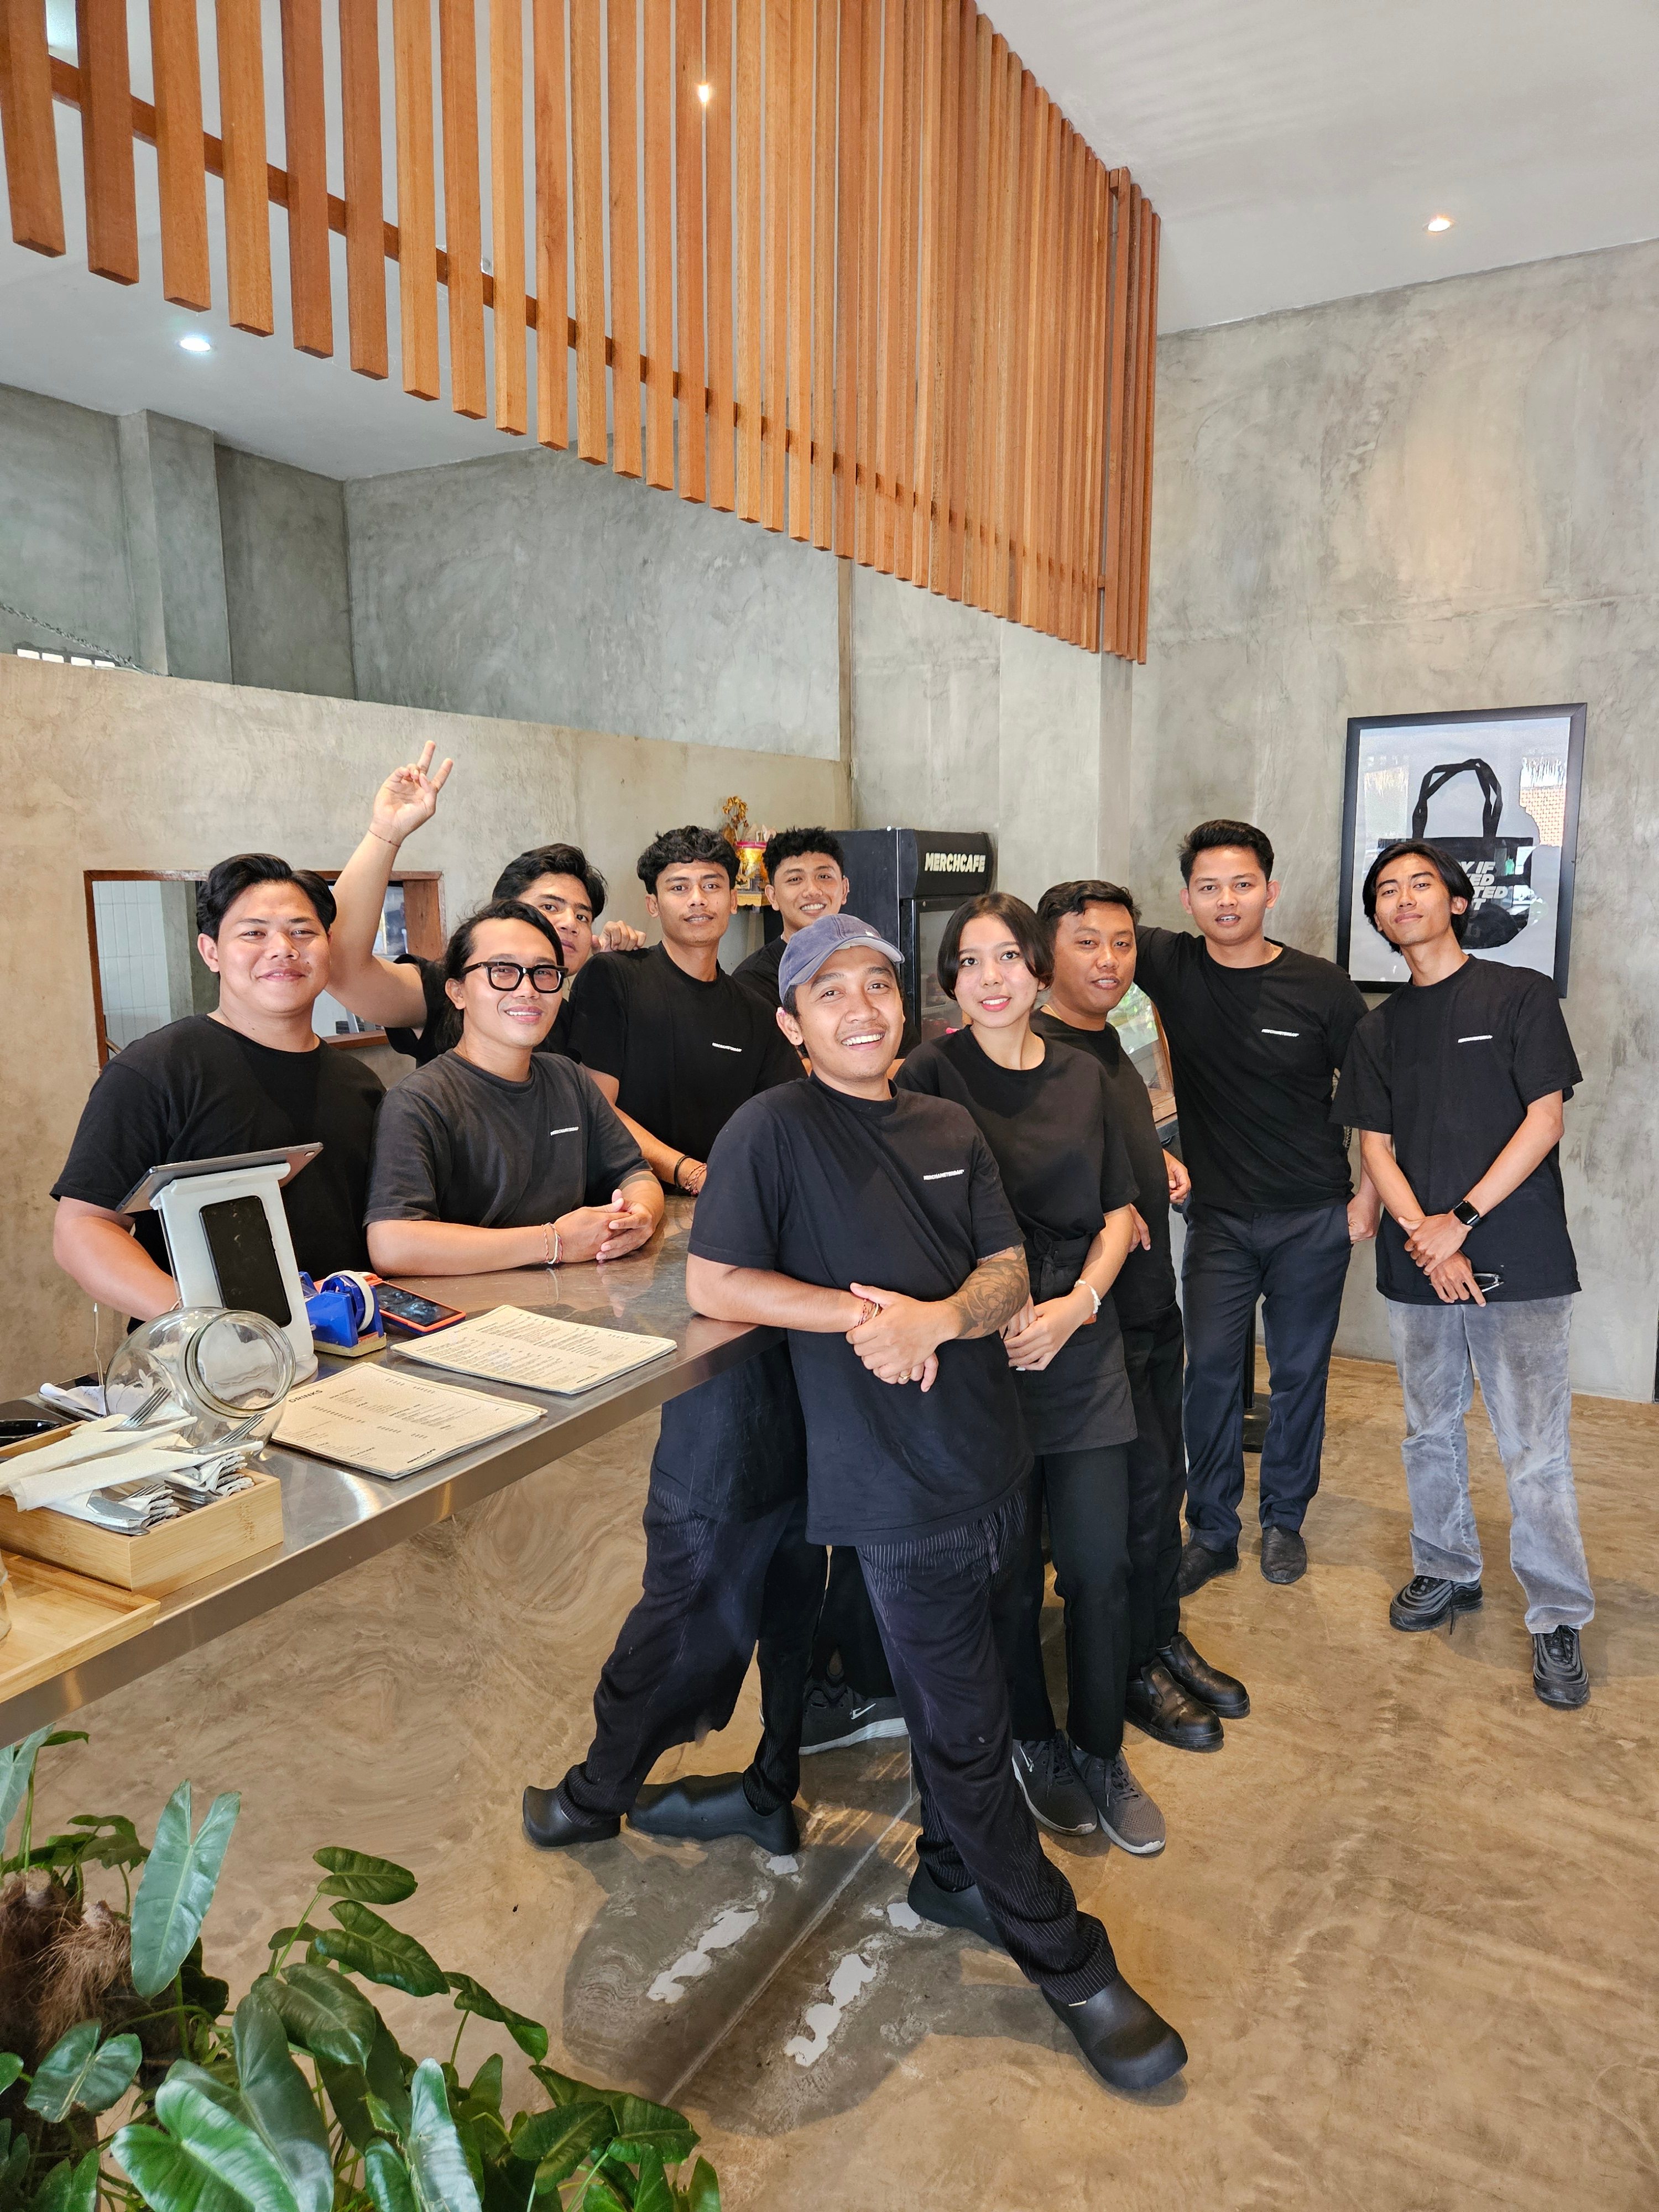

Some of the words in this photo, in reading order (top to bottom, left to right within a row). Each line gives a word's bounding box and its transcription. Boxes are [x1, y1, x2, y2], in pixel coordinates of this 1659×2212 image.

[925, 853, 985, 873] MERCHCAFE
[1475, 862, 1495, 874] IF
[1467, 874, 1495, 886] ED
[1473, 886, 1508, 899] TED
[289, 1390, 323, 1403] DRINKS
